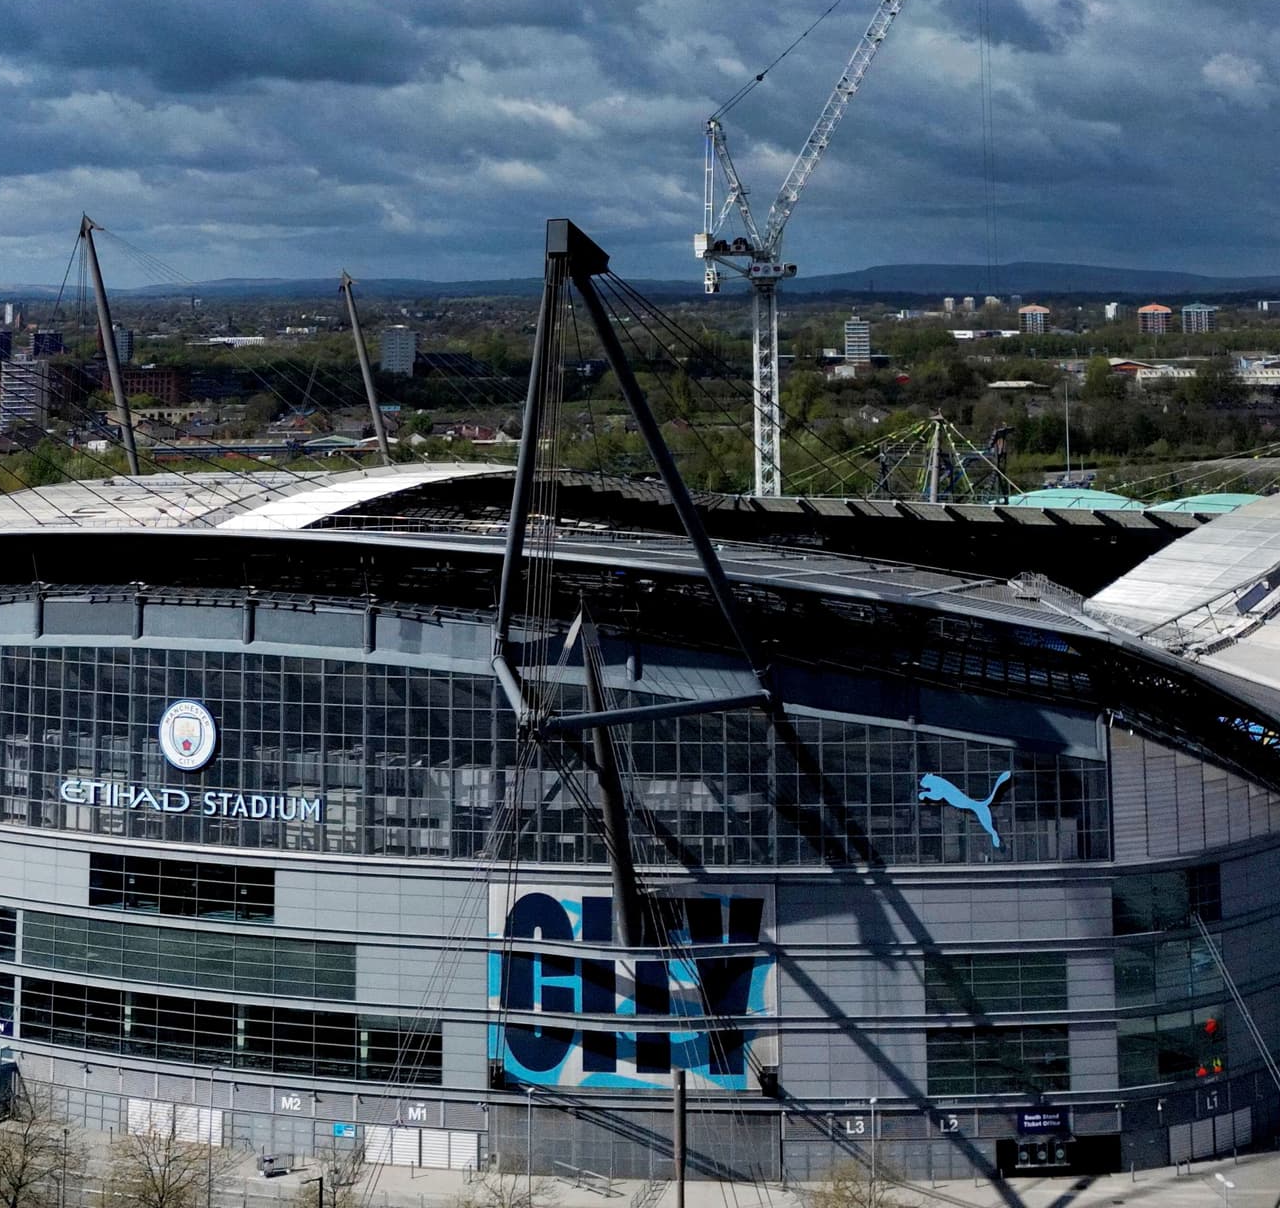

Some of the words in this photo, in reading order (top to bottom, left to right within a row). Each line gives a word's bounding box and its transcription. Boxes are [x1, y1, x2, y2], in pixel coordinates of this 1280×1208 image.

[166, 704, 210, 727] MANCHESTER
[60, 780, 191, 813] ETIHAD
[203, 792, 321, 822] STADIUM
[500, 892, 764, 1075] CITY
[281, 1096, 302, 1111] M2
[1207, 1095, 1218, 1110] L1
[408, 1107, 427, 1121] M1
[846, 1120, 865, 1134] L3
[940, 1118, 959, 1133] L2
